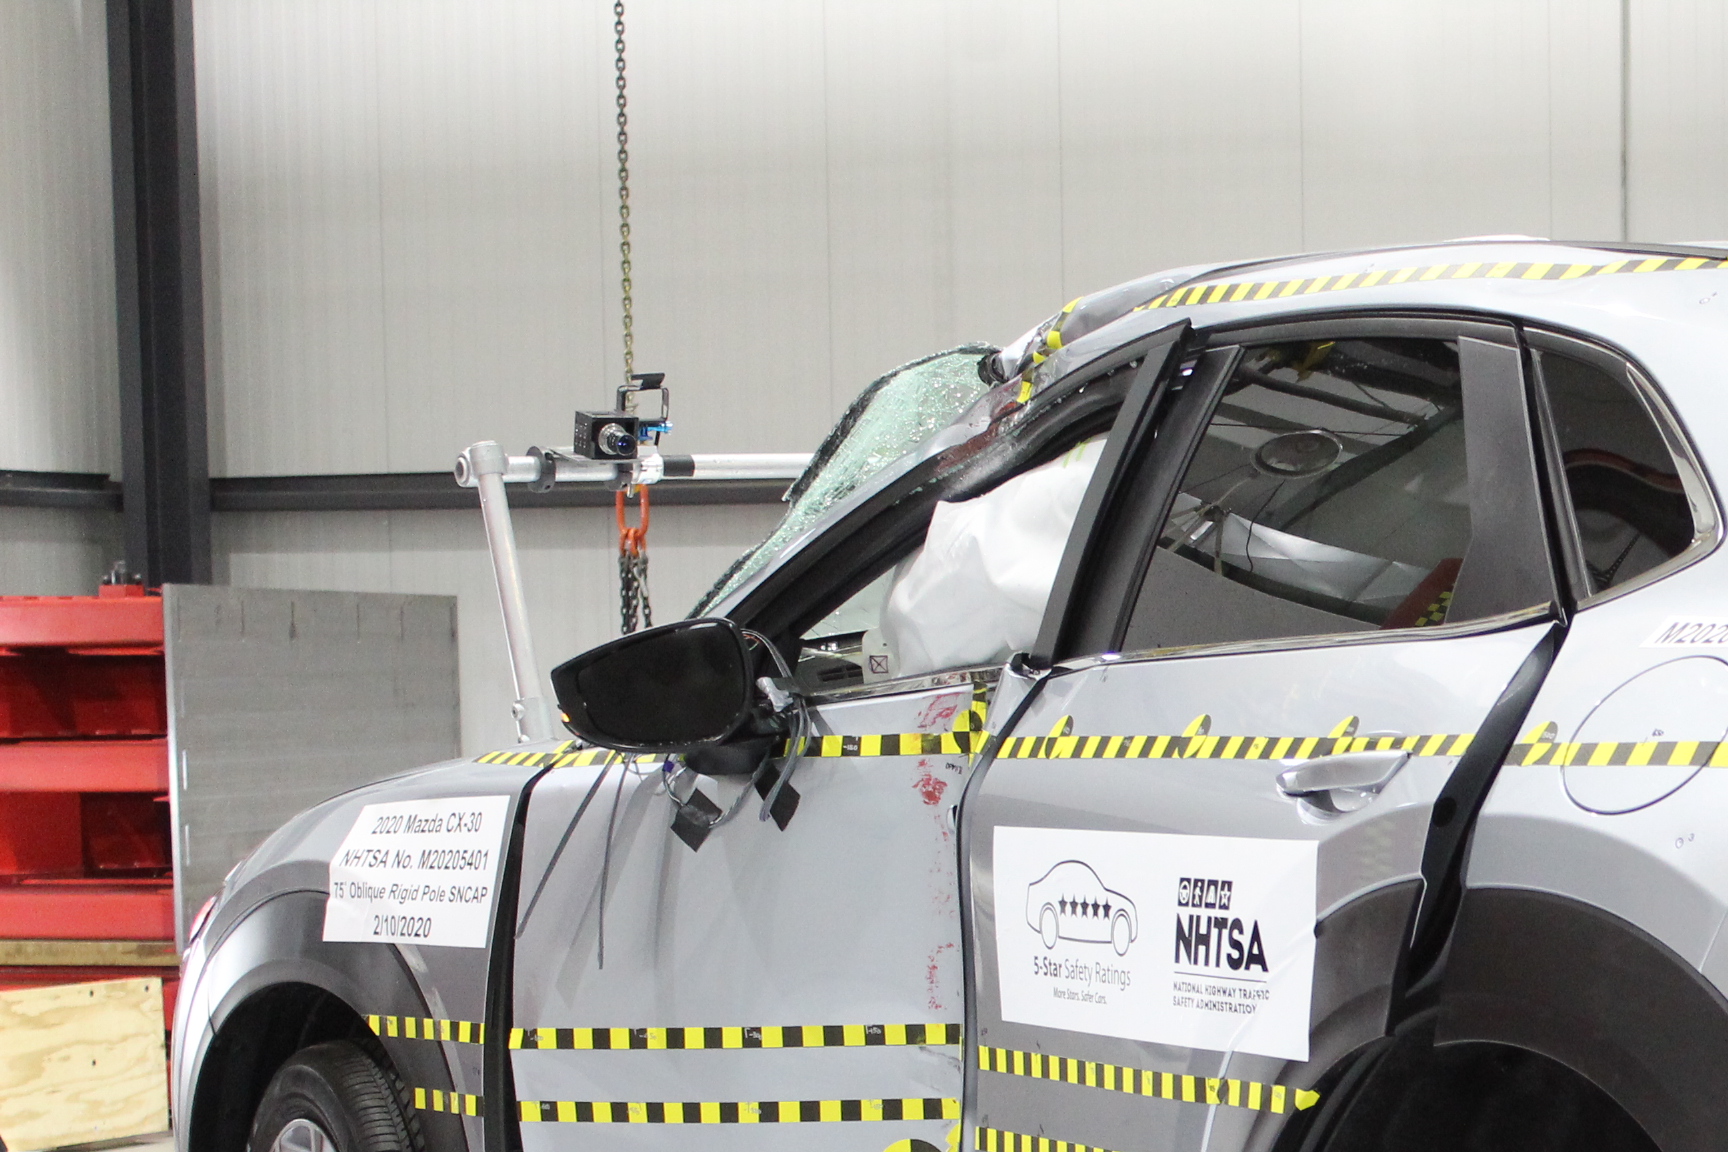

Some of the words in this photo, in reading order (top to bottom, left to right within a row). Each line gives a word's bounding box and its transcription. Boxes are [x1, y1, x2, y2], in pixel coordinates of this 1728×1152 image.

[371, 815, 404, 834] 2020
[403, 813, 443, 834] Mazda
[446, 812, 482, 833] CX-30
[339, 849, 389, 868] NHTSA
[391, 849, 413, 869] No.
[418, 849, 489, 871] M20205401
[349, 881, 386, 903] Oblique
[388, 883, 420, 905] Rigid
[421, 885, 446, 903] Pole
[448, 886, 488, 904] SNCAP
[373, 914, 432, 938] 2/10/2020
[1174, 912, 1269, 973] NHTSA
[1034, 955, 1062, 978] 5-Star
[1064, 958, 1093, 988] Safety
[1095, 961, 1131, 992] Ratings
[1053, 986, 1066, 1000] More
[1173, 981, 1203, 995] NATIONAL
[1205, 985, 1237, 998] HIGHWAY
[1173, 995, 1195, 1009] SAFETY
